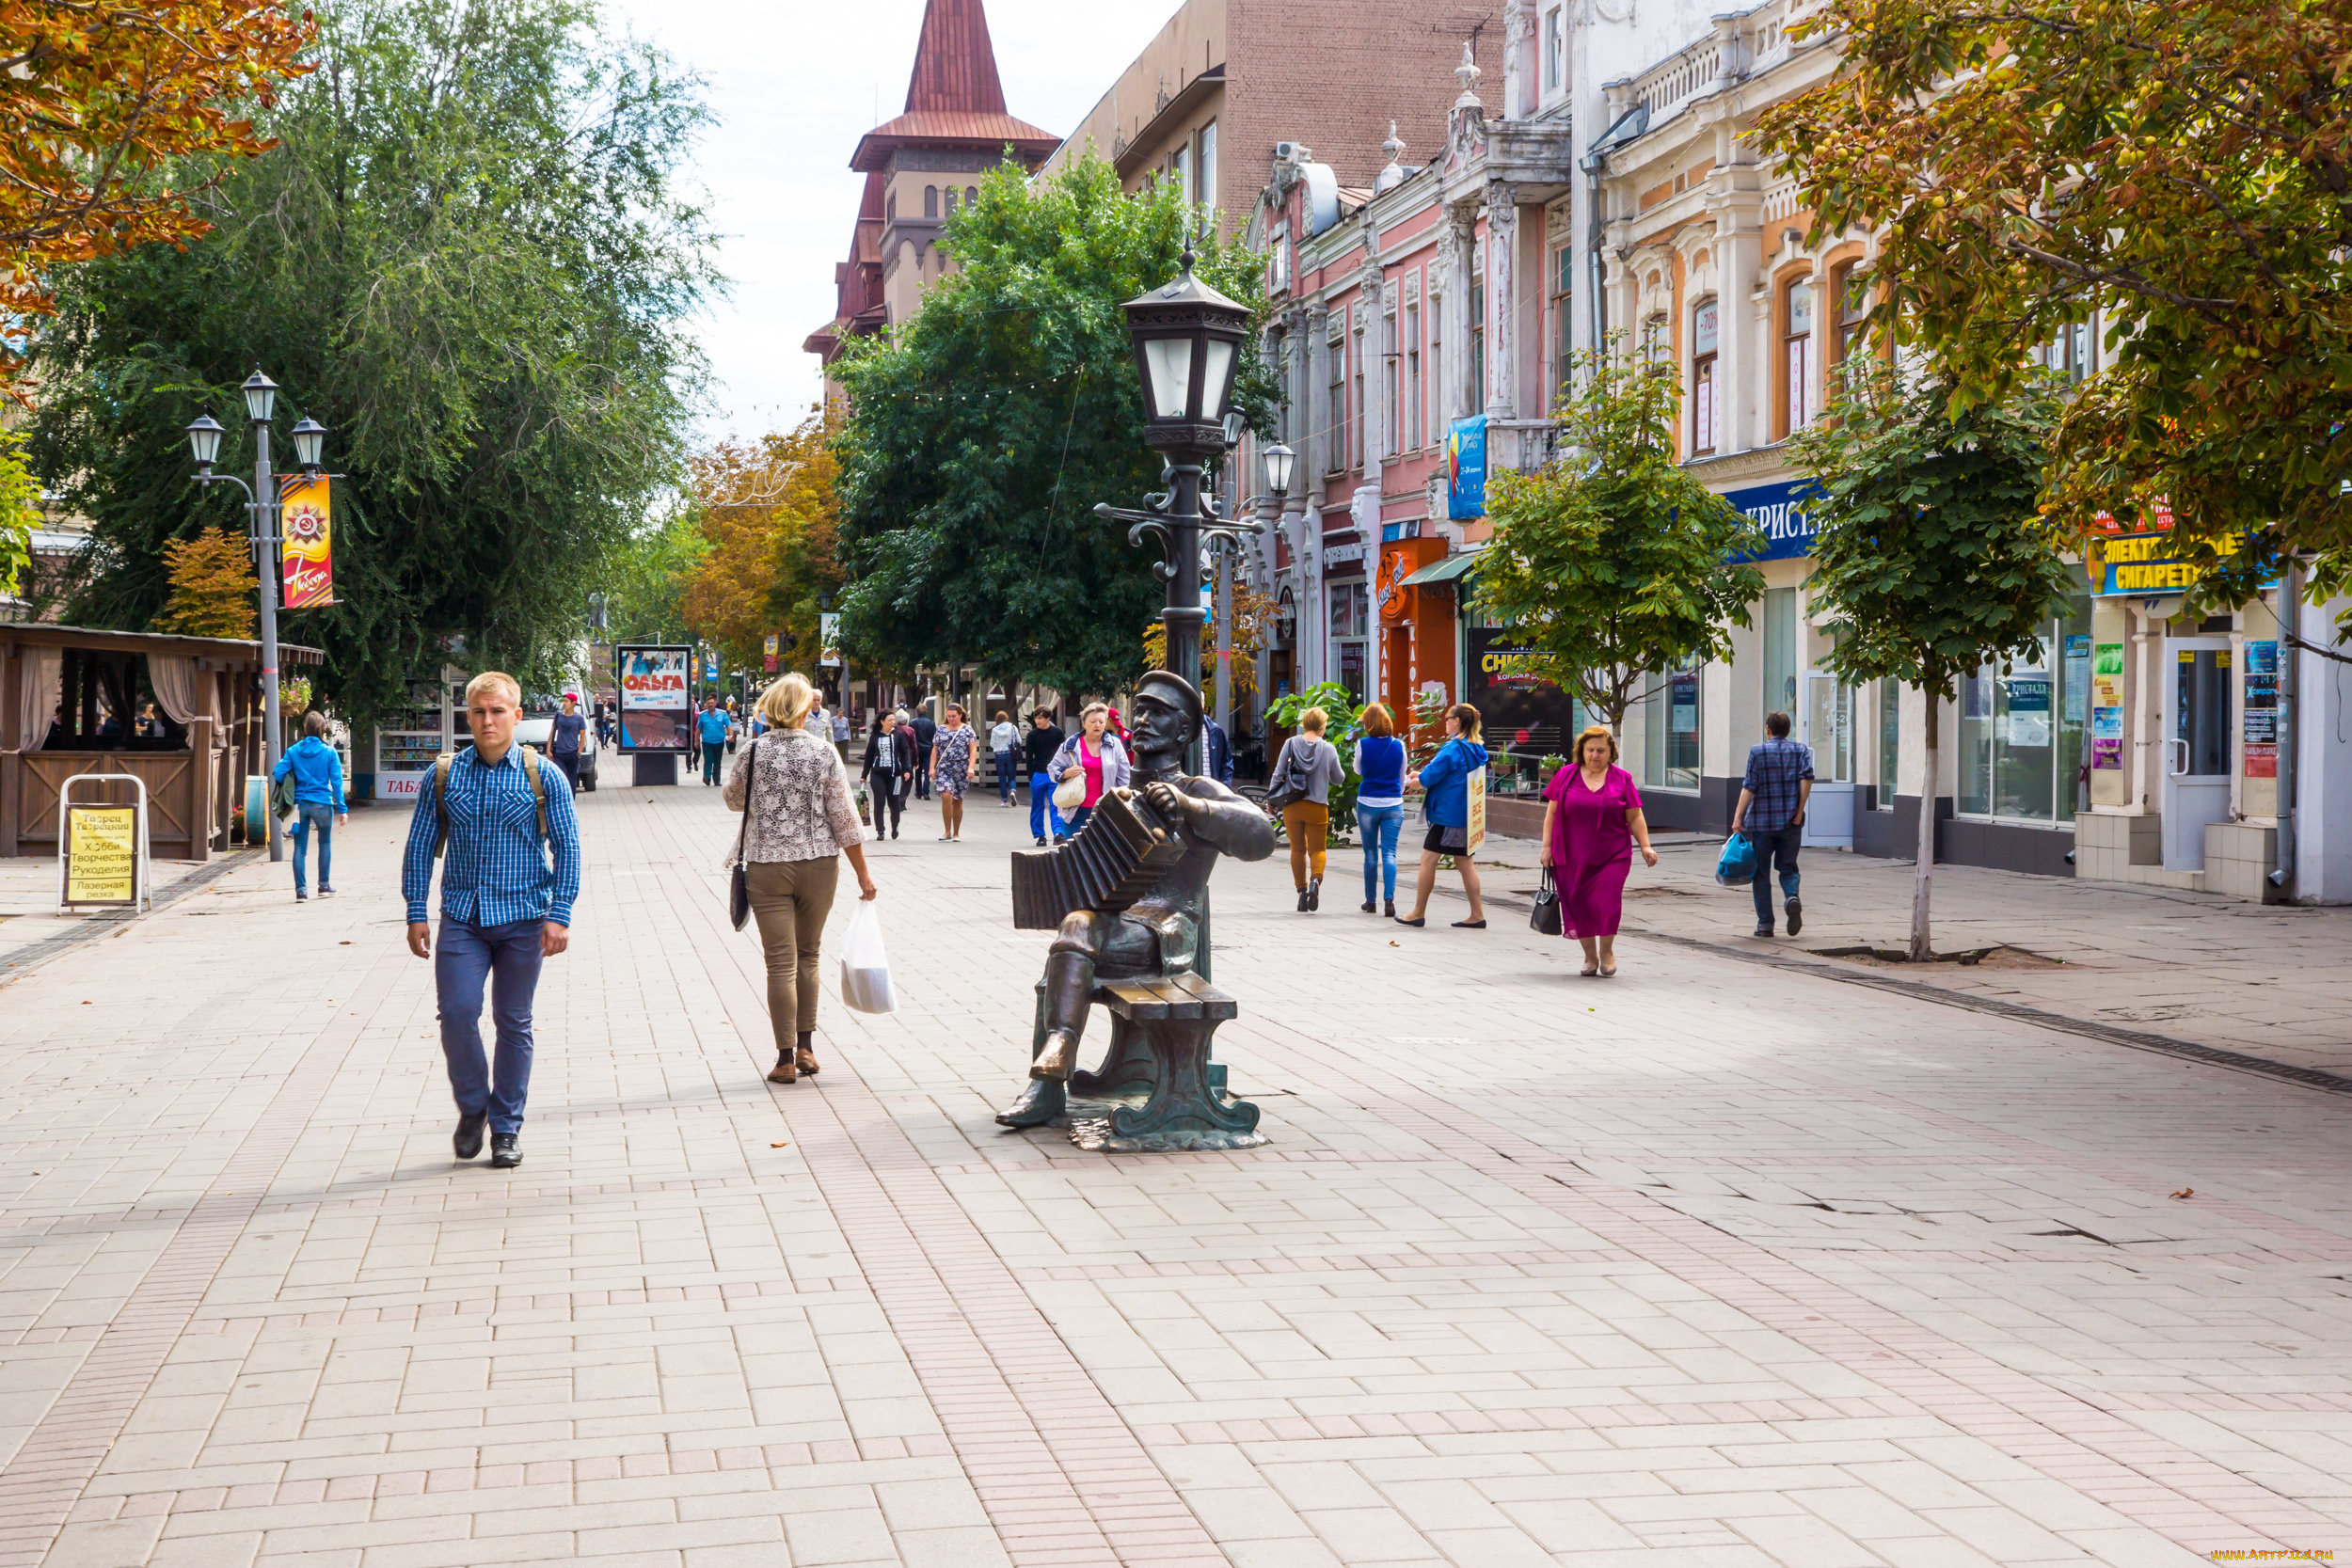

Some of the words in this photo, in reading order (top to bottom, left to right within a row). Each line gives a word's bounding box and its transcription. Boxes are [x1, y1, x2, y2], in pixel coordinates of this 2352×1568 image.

[623, 674, 685, 690] ОЛЬГА
[71, 853, 132, 863] Творчества
[72, 866, 130, 876] Рукоделия
[76, 881, 125, 891] Лазерная
